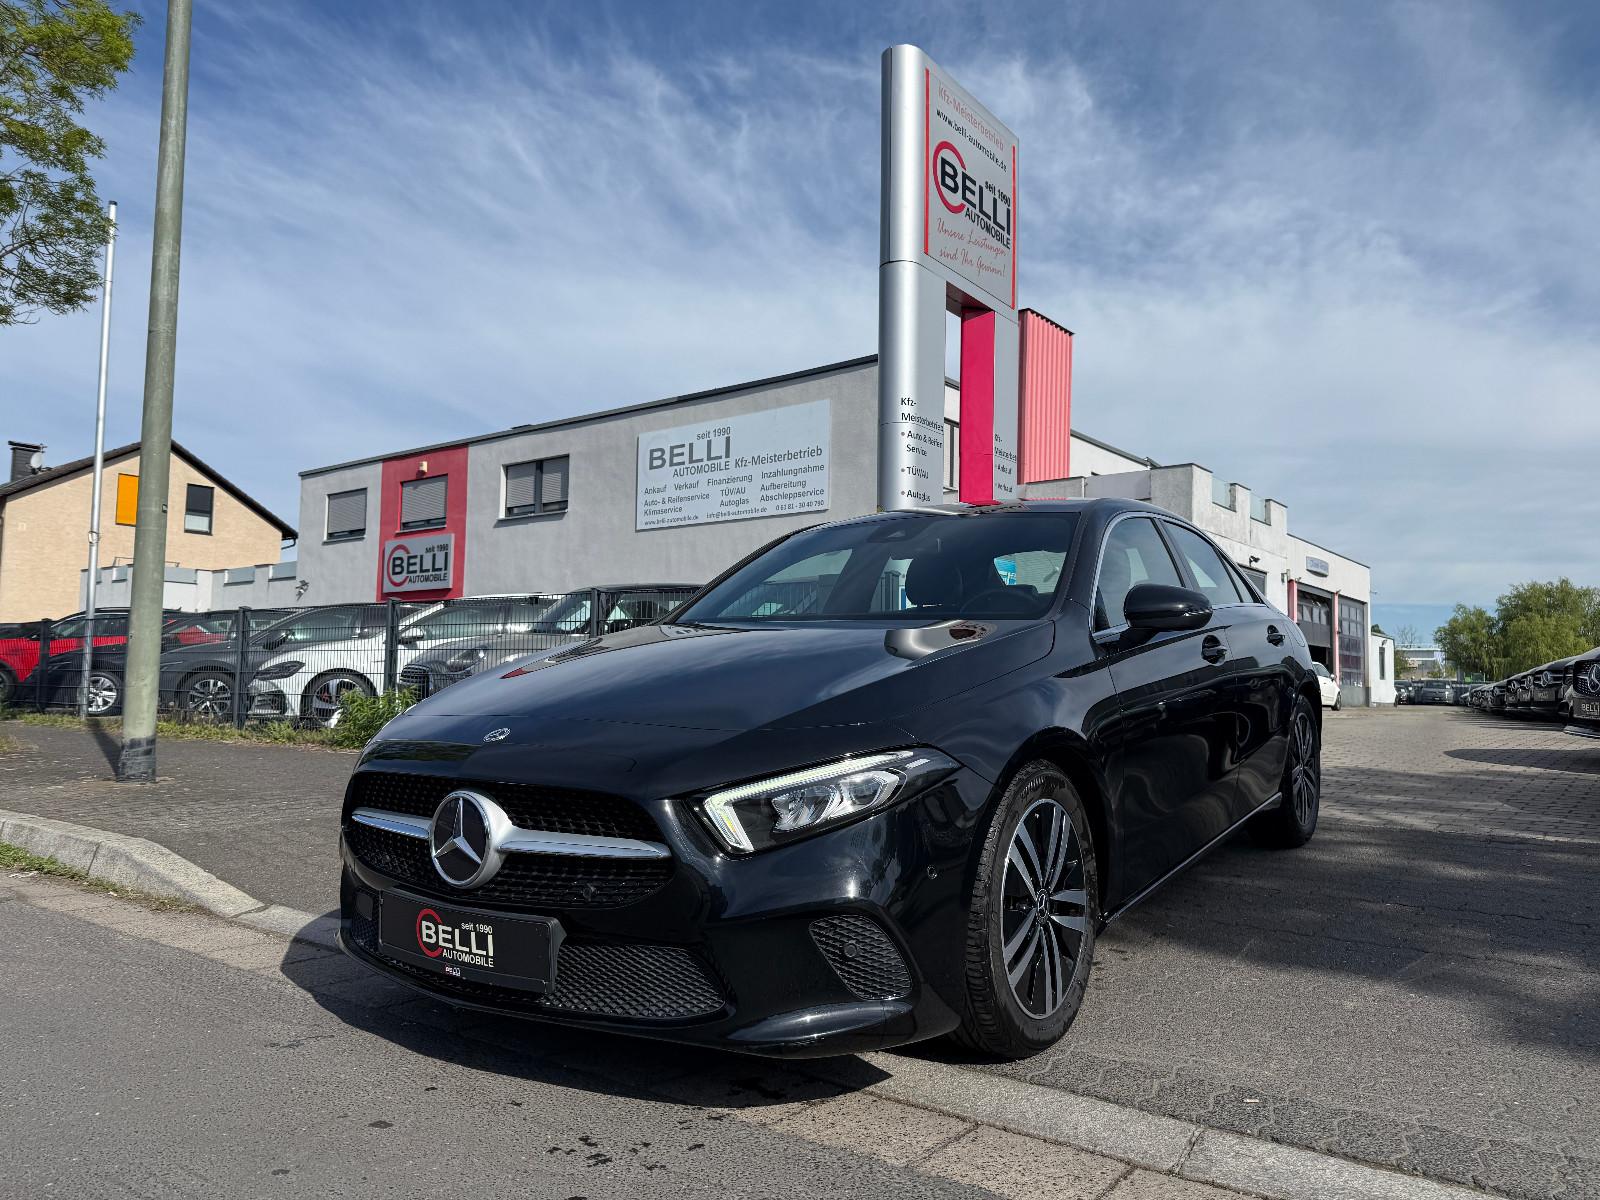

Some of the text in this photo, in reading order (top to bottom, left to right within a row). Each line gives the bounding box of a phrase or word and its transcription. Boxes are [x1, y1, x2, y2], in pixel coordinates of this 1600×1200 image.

[940, 156, 1011, 236] BELLI
[984, 180, 1011, 208] seit 1990
[965, 207, 1011, 250] AUTOMOBILE
[939, 246, 959, 261] sind
[900, 397, 917, 407] Kfz-
[696, 426, 731, 441] seit 1990
[648, 436, 731, 471] BELLI
[734, 445, 823, 469] Kfz-Meisterbetrieb
[672, 460, 730, 478] AUTOMOBILE
[644, 463, 825, 495] Ankauf Verkauf Finanzierung Inzahlungnahme
[760, 479, 807, 492] Aufbereitung
[667, 492, 710, 505] Reifenservice
[720, 486, 746, 497] TÜV/AU
[760, 487, 825, 503] Abschleppservice
[719, 497, 750, 508] Autoglas
[643, 505, 683, 517] Klimaservice
[425, 546, 436, 554] seit
[391, 552, 448, 576] BELLI
[408, 572, 448, 584] AUTOMOBILE
[460, 922, 493, 934] seit 1990
[421, 920, 494, 957] BELLI
[442, 949, 495, 968] AUTOMOBILE
